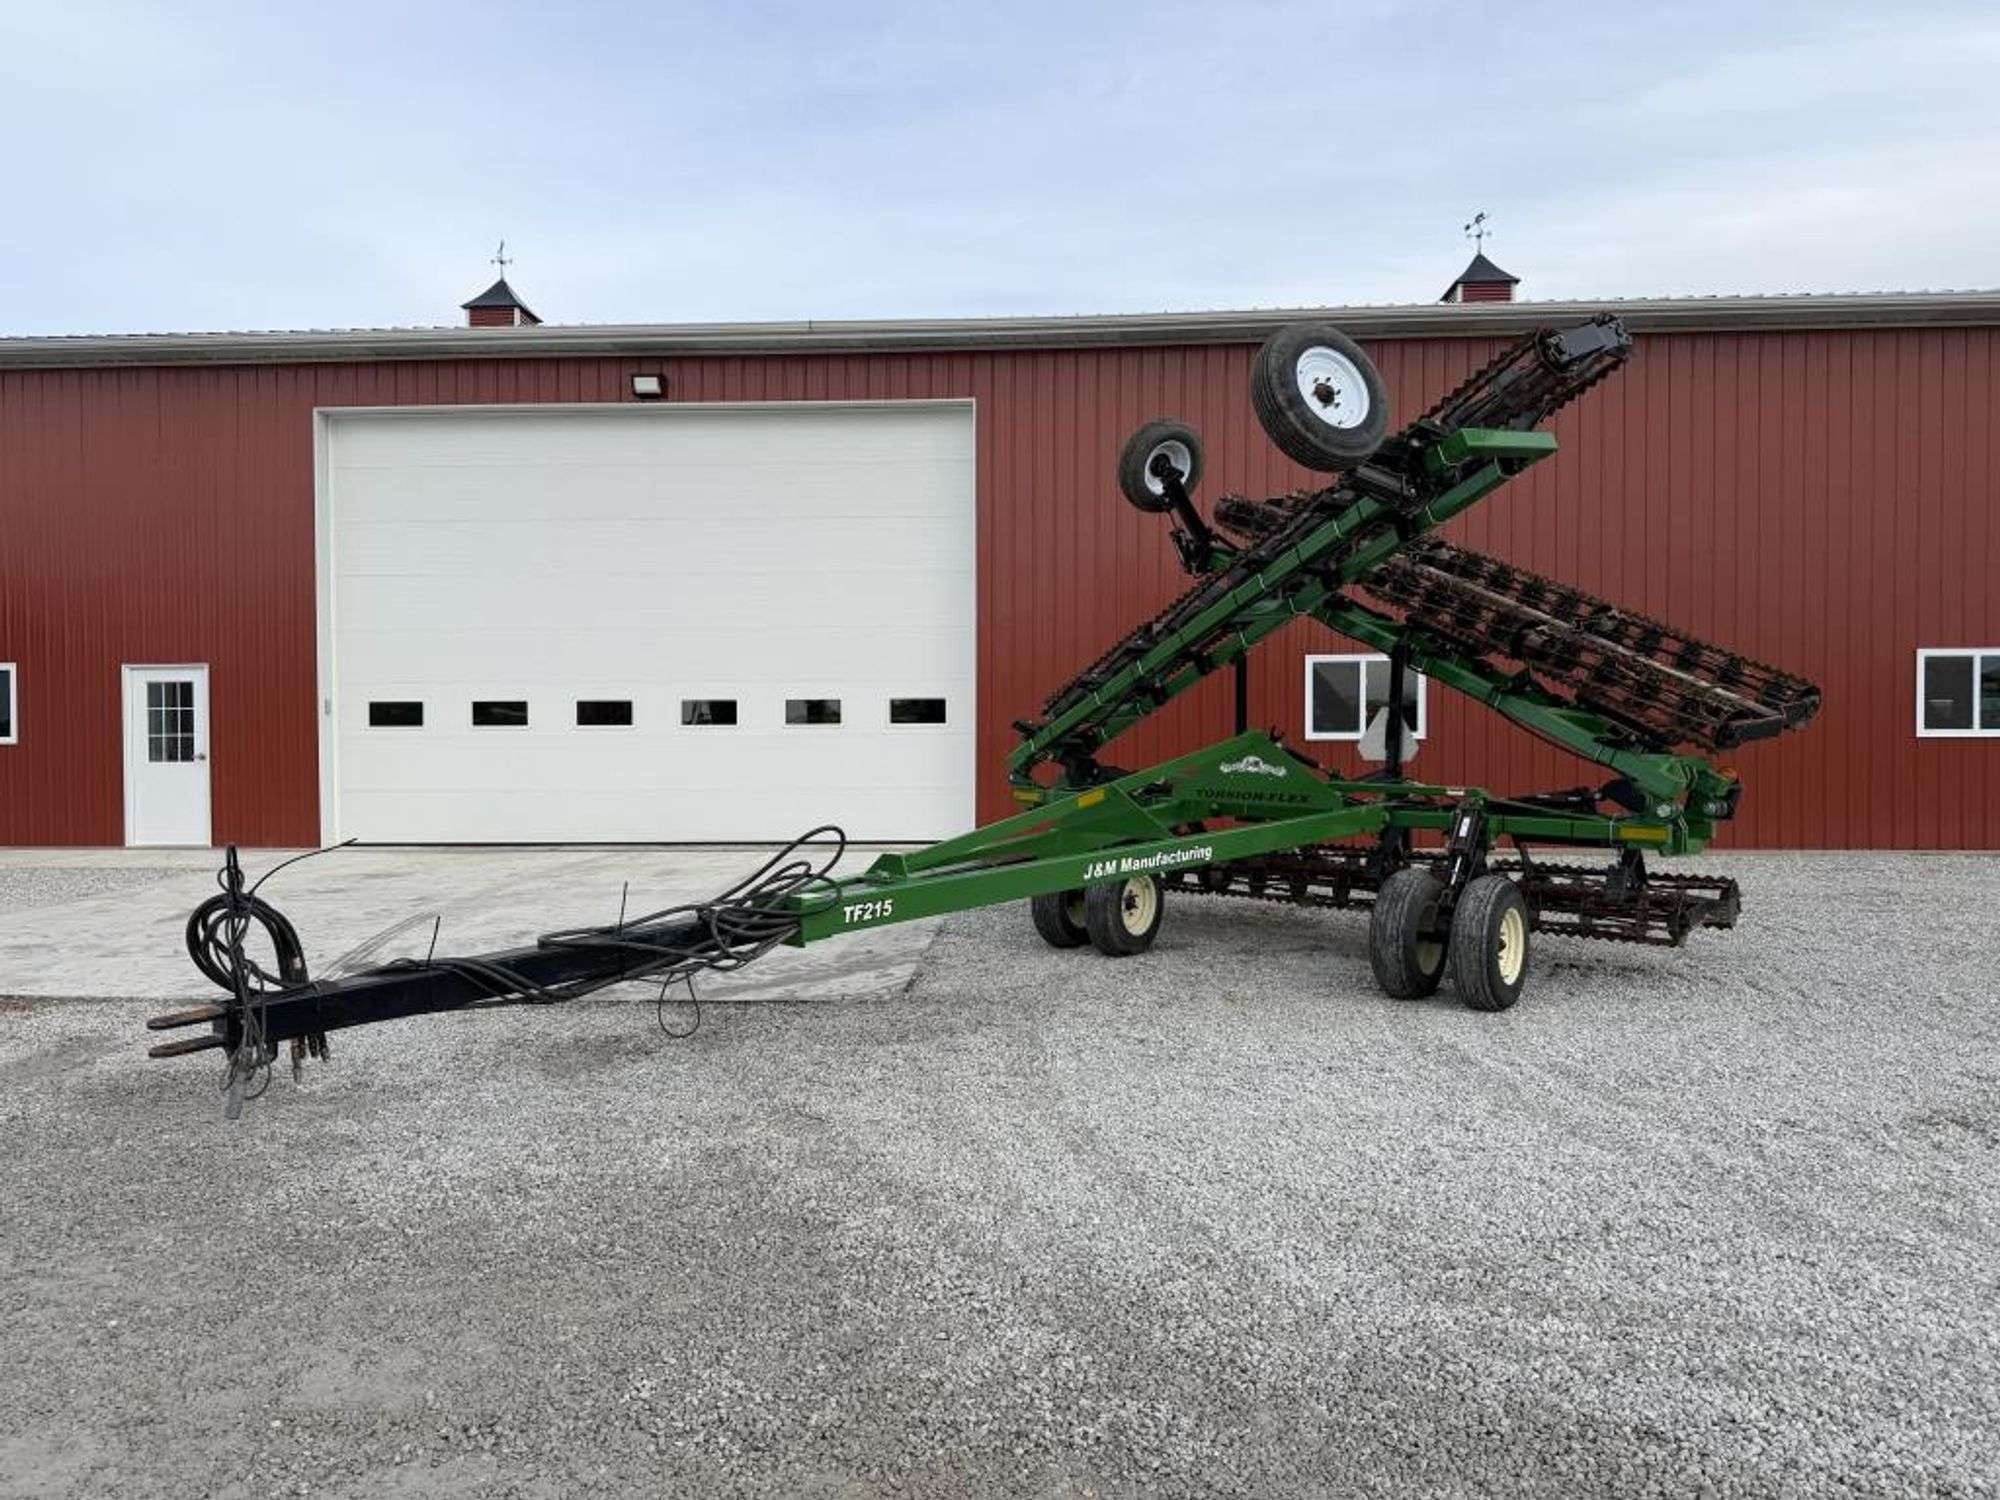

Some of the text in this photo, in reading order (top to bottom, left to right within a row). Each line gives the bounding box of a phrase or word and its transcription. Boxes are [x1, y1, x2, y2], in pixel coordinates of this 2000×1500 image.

[1083, 845, 1213, 880] J&M Manufacturing
[843, 899, 893, 923] TF215
